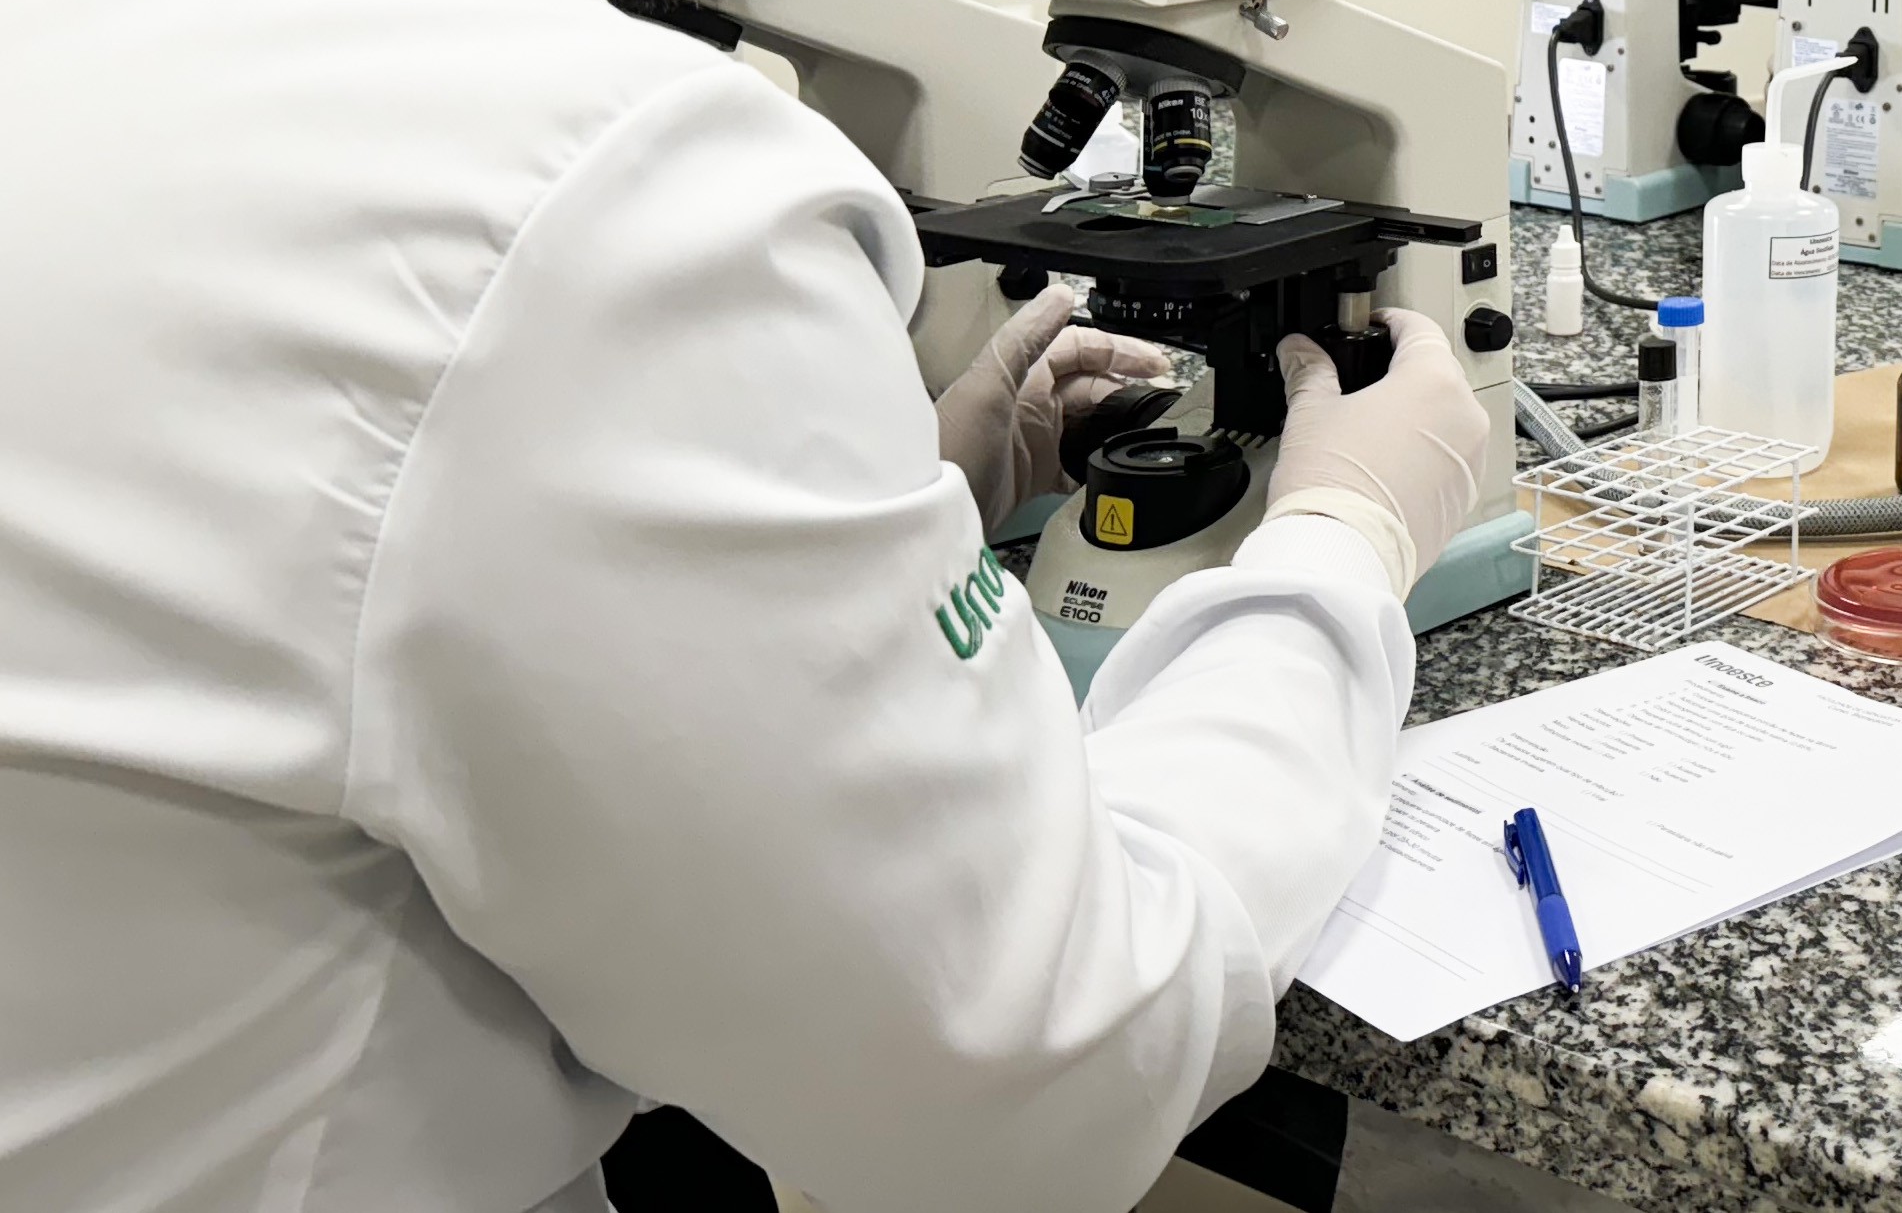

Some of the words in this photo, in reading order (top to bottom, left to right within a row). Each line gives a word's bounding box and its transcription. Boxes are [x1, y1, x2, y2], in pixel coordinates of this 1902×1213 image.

[1066, 580, 1108, 601] Nikon
[1060, 606, 1101, 623] E100
[1694, 654, 1774, 688] Unoeste
